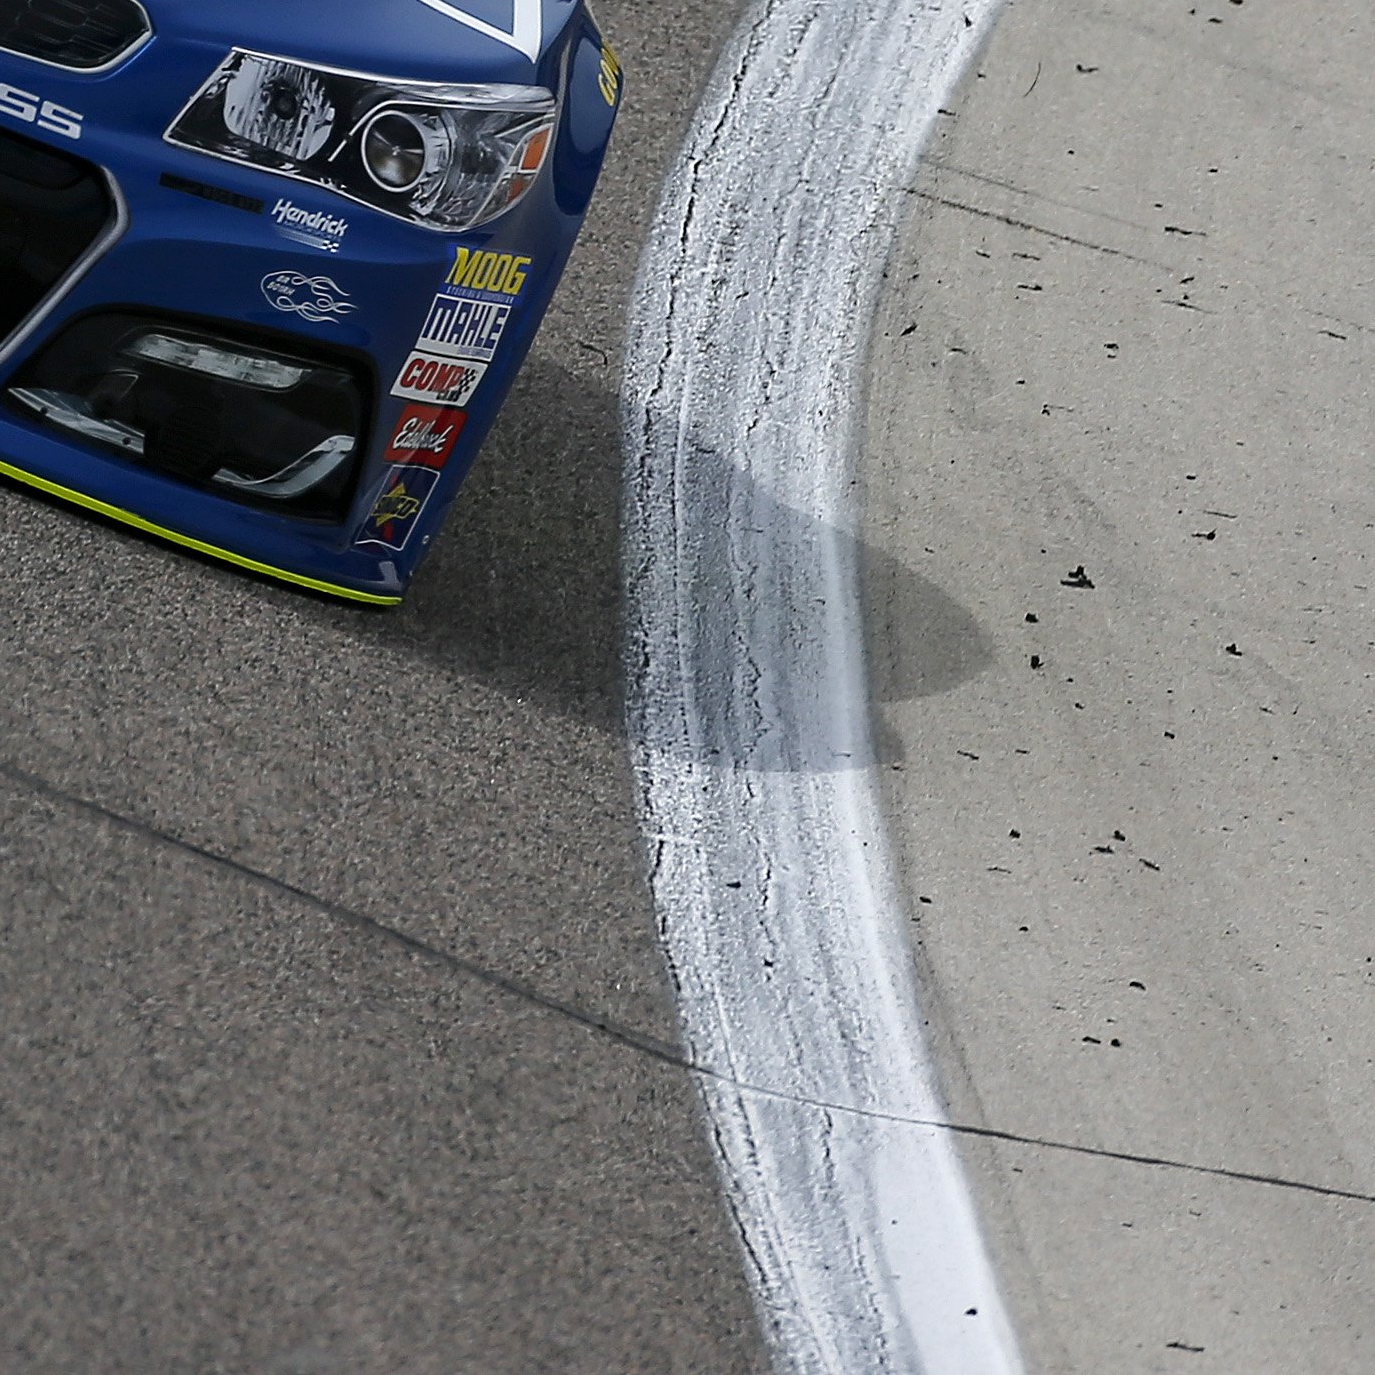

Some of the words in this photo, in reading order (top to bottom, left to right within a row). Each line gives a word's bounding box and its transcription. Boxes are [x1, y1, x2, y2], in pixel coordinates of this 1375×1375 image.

[270, 198, 349, 237] Hendrick
[444, 246, 532, 296] MOOG
[421, 297, 507, 350] MAHLE
[399, 358, 465, 393] COMP
